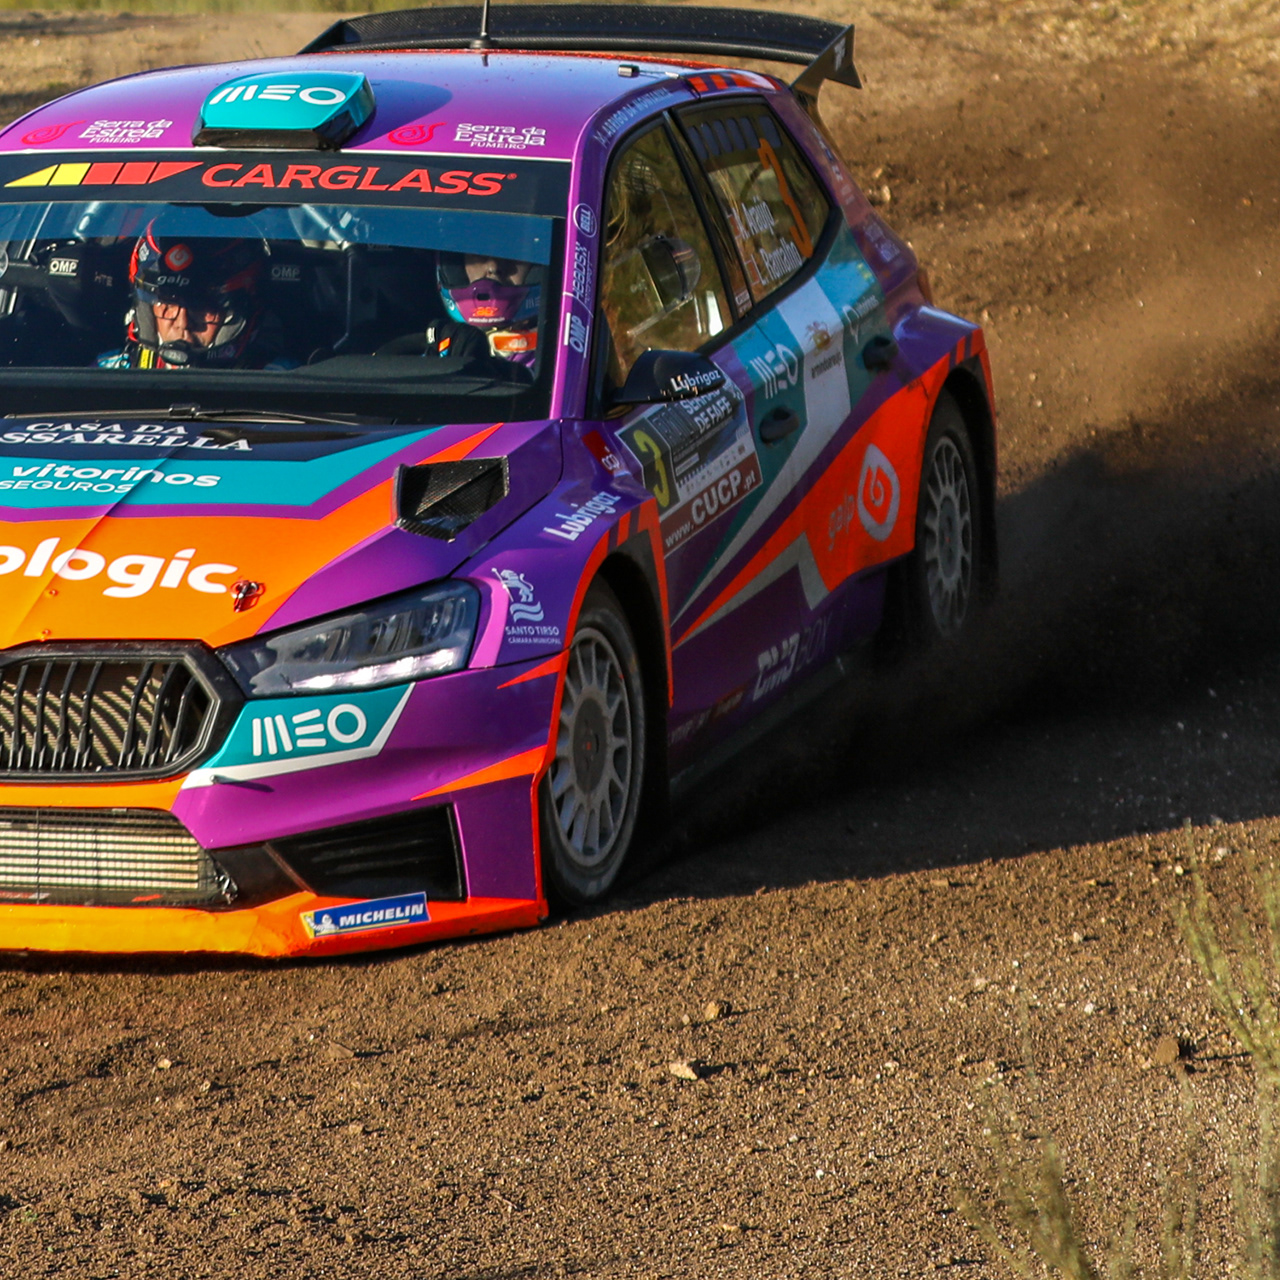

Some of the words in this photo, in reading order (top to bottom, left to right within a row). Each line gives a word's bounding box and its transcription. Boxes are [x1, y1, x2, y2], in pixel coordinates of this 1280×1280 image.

[209, 83, 347, 106] MEO
[91, 119, 145, 129] Serra
[146, 118, 173, 129] da
[456, 122, 518, 134] Serra
[520, 125, 547, 136] da
[78, 126, 167, 139] Estrela
[453, 131, 546, 147] Estrela
[470, 141, 527, 150] FUMEIRO
[50, 260, 77, 274] OMP
[759, 237, 804, 281] Ramalho
[156, 273, 190, 288] galp
[271, 267, 300, 279] OMP
[570, 315, 586, 354] OMP
[694, 411, 714, 434] DE
[704, 396, 733, 425] FAFE
[26, 422, 124, 434] CASA
[131, 423, 189, 435] DA
[12, 463, 222, 487] vitorinos
[633, 429, 670, 508] 3
[543, 491, 622, 542] Lubrigaz
[505, 625, 535, 636] SANTO
[535, 625, 560, 636] TIRSO
[252, 703, 368, 757] MEO
[339, 903, 425, 928] MICHELIN
